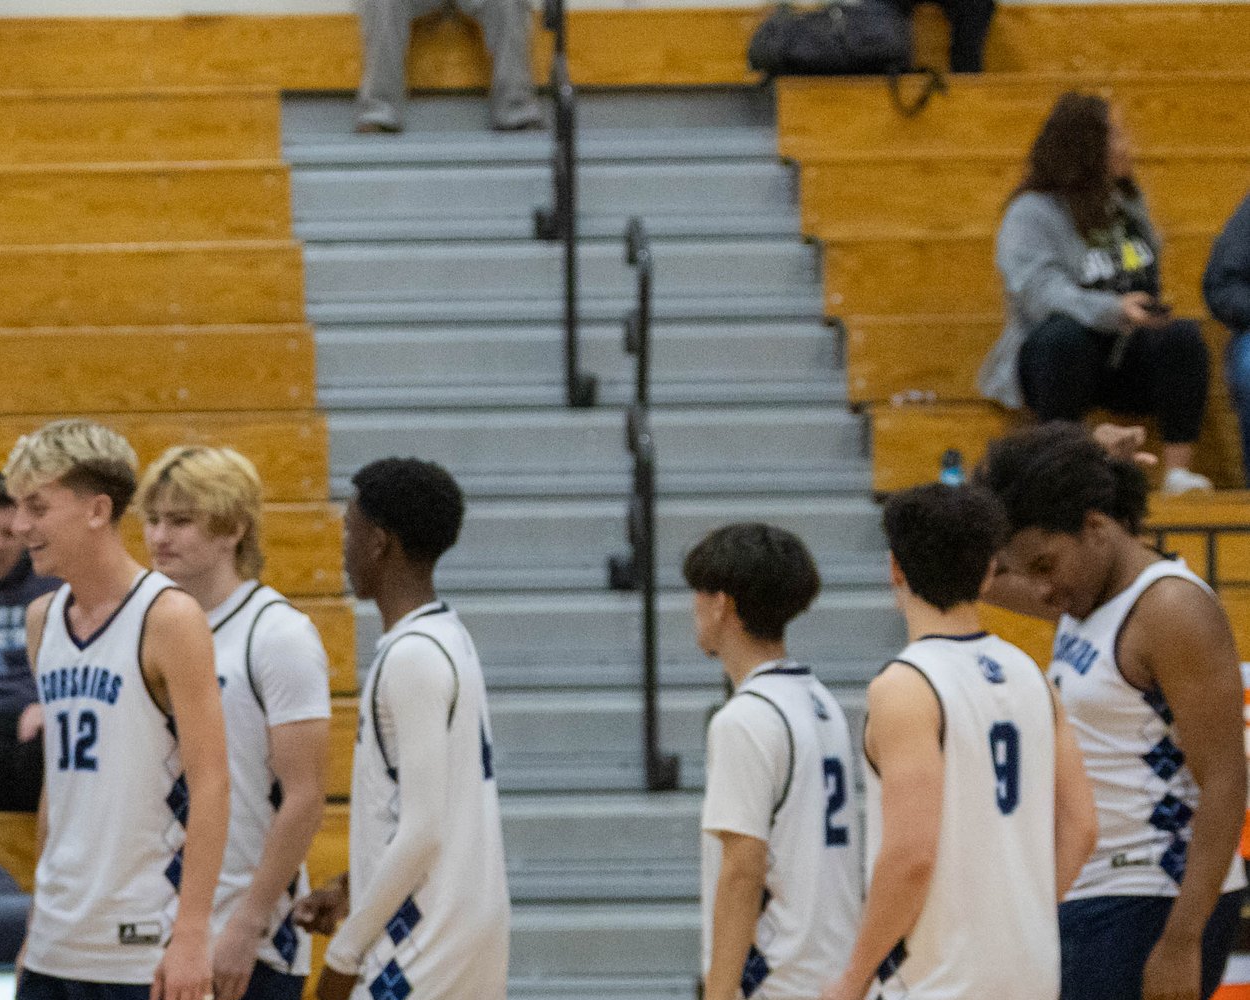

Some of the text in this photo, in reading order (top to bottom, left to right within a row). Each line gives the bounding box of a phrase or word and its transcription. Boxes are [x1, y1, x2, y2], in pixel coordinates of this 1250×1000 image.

[56, 708, 98, 771] 12
[989, 719, 1020, 816] 9
[822, 756, 849, 847] 2
